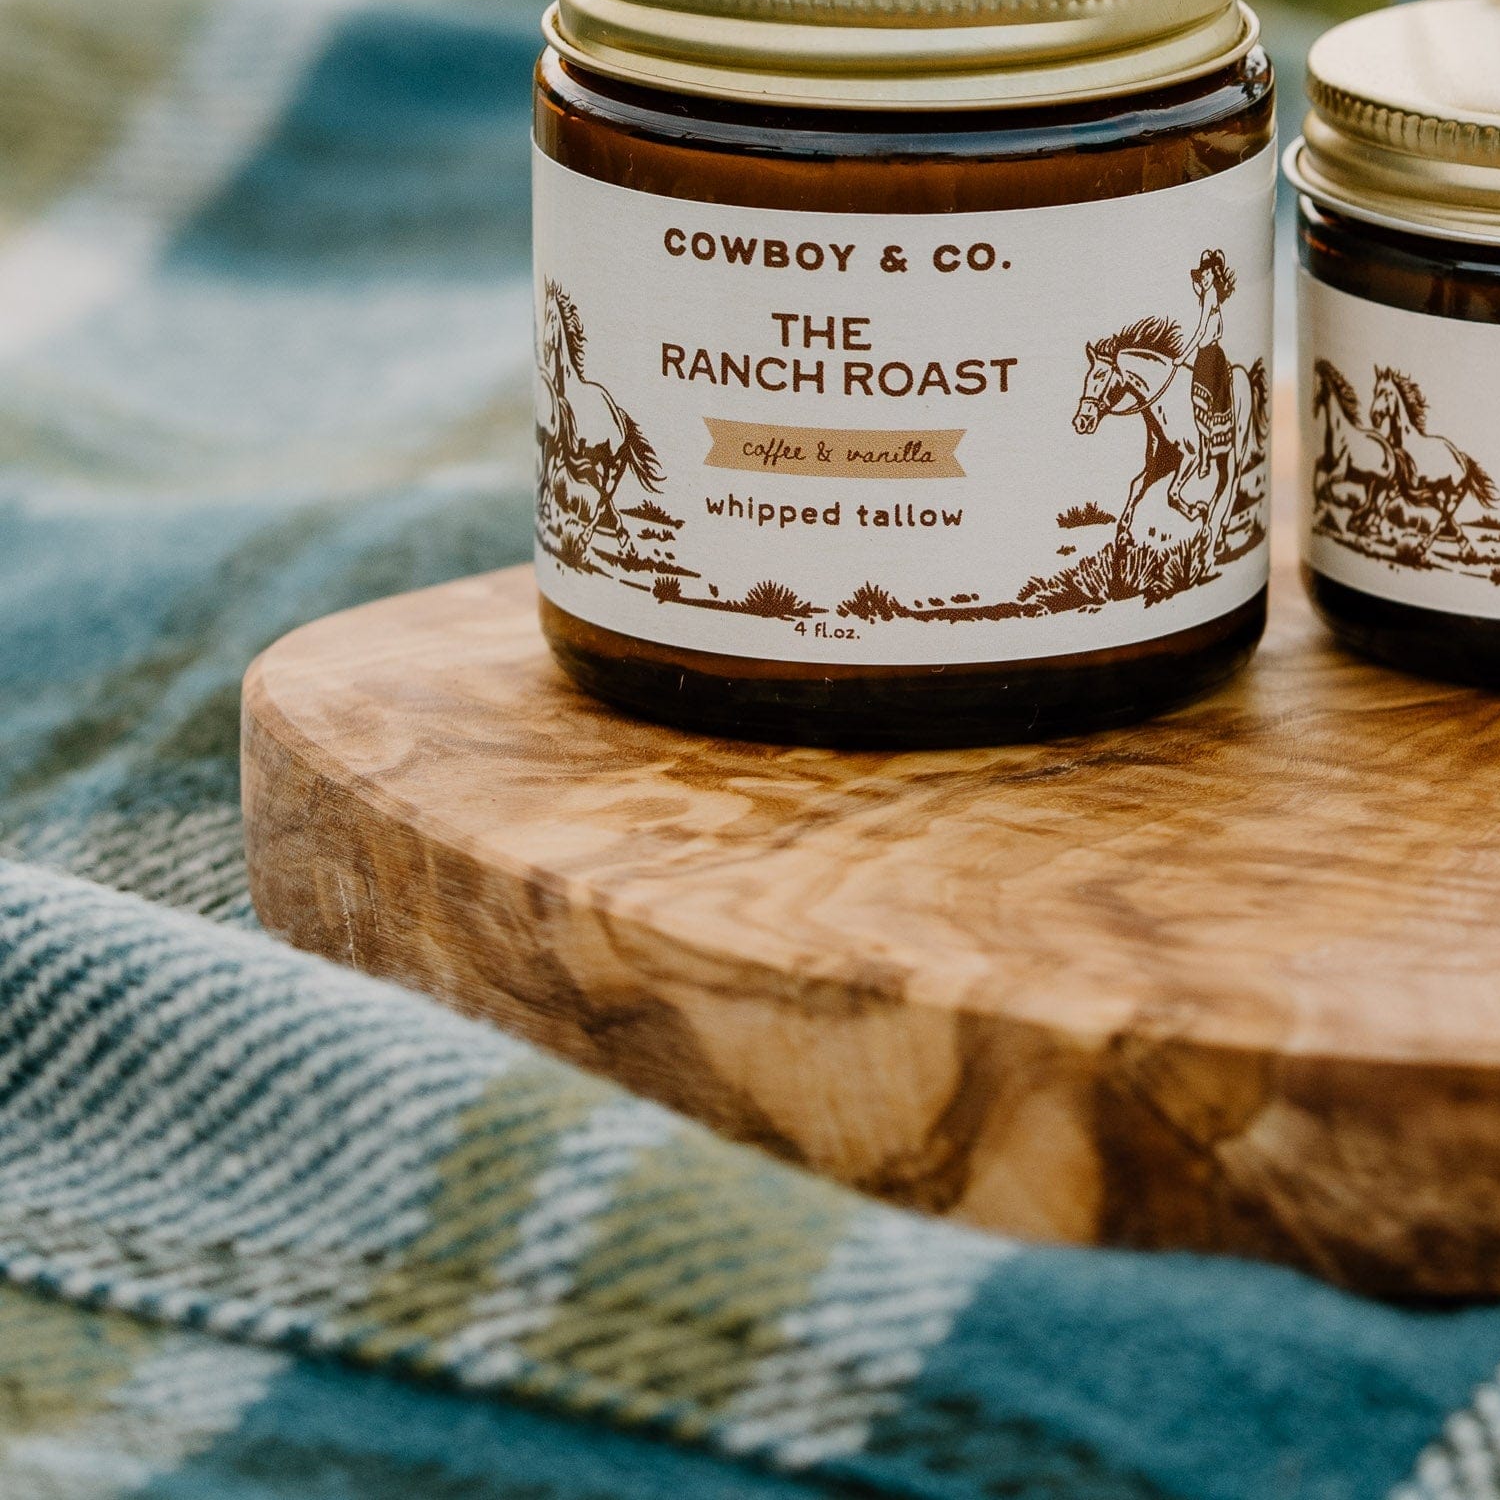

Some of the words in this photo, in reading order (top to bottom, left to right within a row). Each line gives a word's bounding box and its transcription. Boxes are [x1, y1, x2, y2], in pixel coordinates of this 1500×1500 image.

[664, 227, 856, 272] COWBOY
[879, 245, 908, 273] &
[933, 243, 1012, 273] CO.
[771, 312, 872, 351] THE
[661, 343, 825, 394] RANCH
[843, 358, 1018, 397] ROAST
[742, 437, 807, 467] coffee
[815, 441, 834, 463] &
[845, 440, 937, 465] vanilla
[705, 494, 840, 528] whipped
[856, 503, 964, 528] tallow
[794, 621, 807, 636] 4
